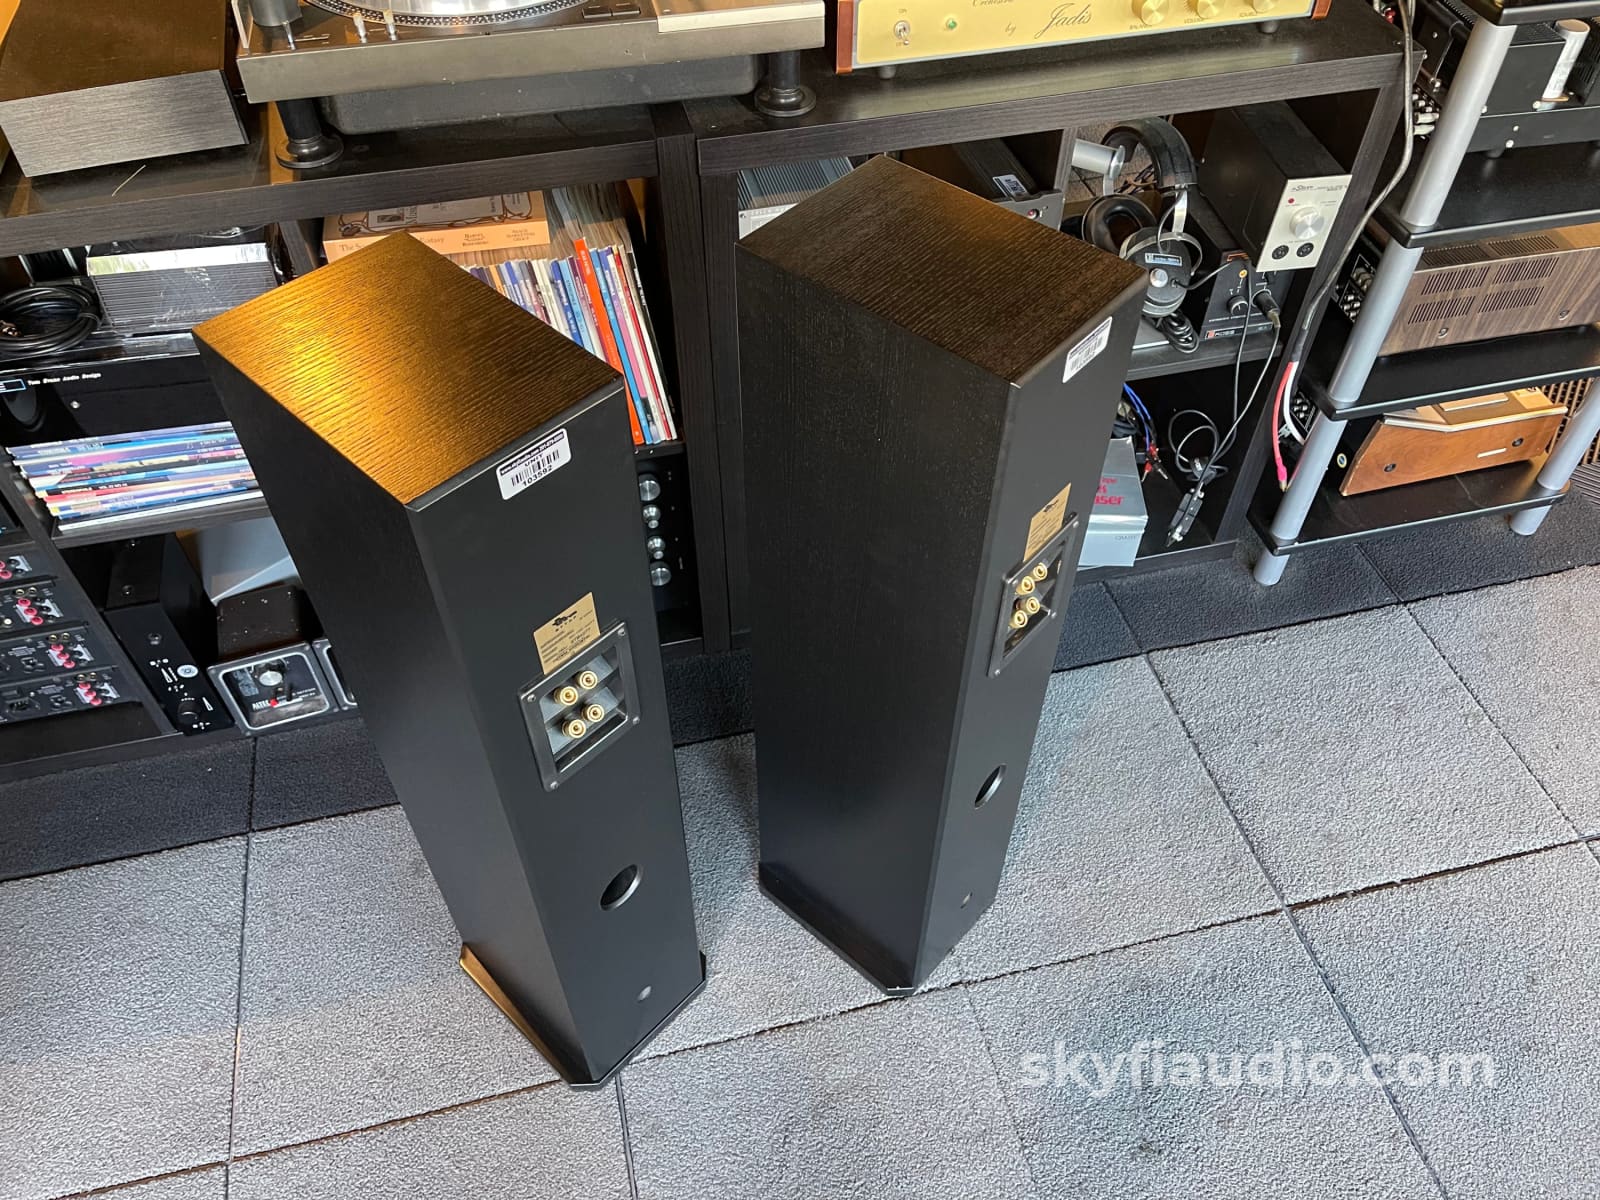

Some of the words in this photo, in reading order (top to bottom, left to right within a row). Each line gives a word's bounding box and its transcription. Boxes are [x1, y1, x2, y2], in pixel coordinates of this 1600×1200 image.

[1034, 3, 1092, 39] Jadis
[524, 453, 543, 467] UNIT
[522, 464, 553, 487] 103592
